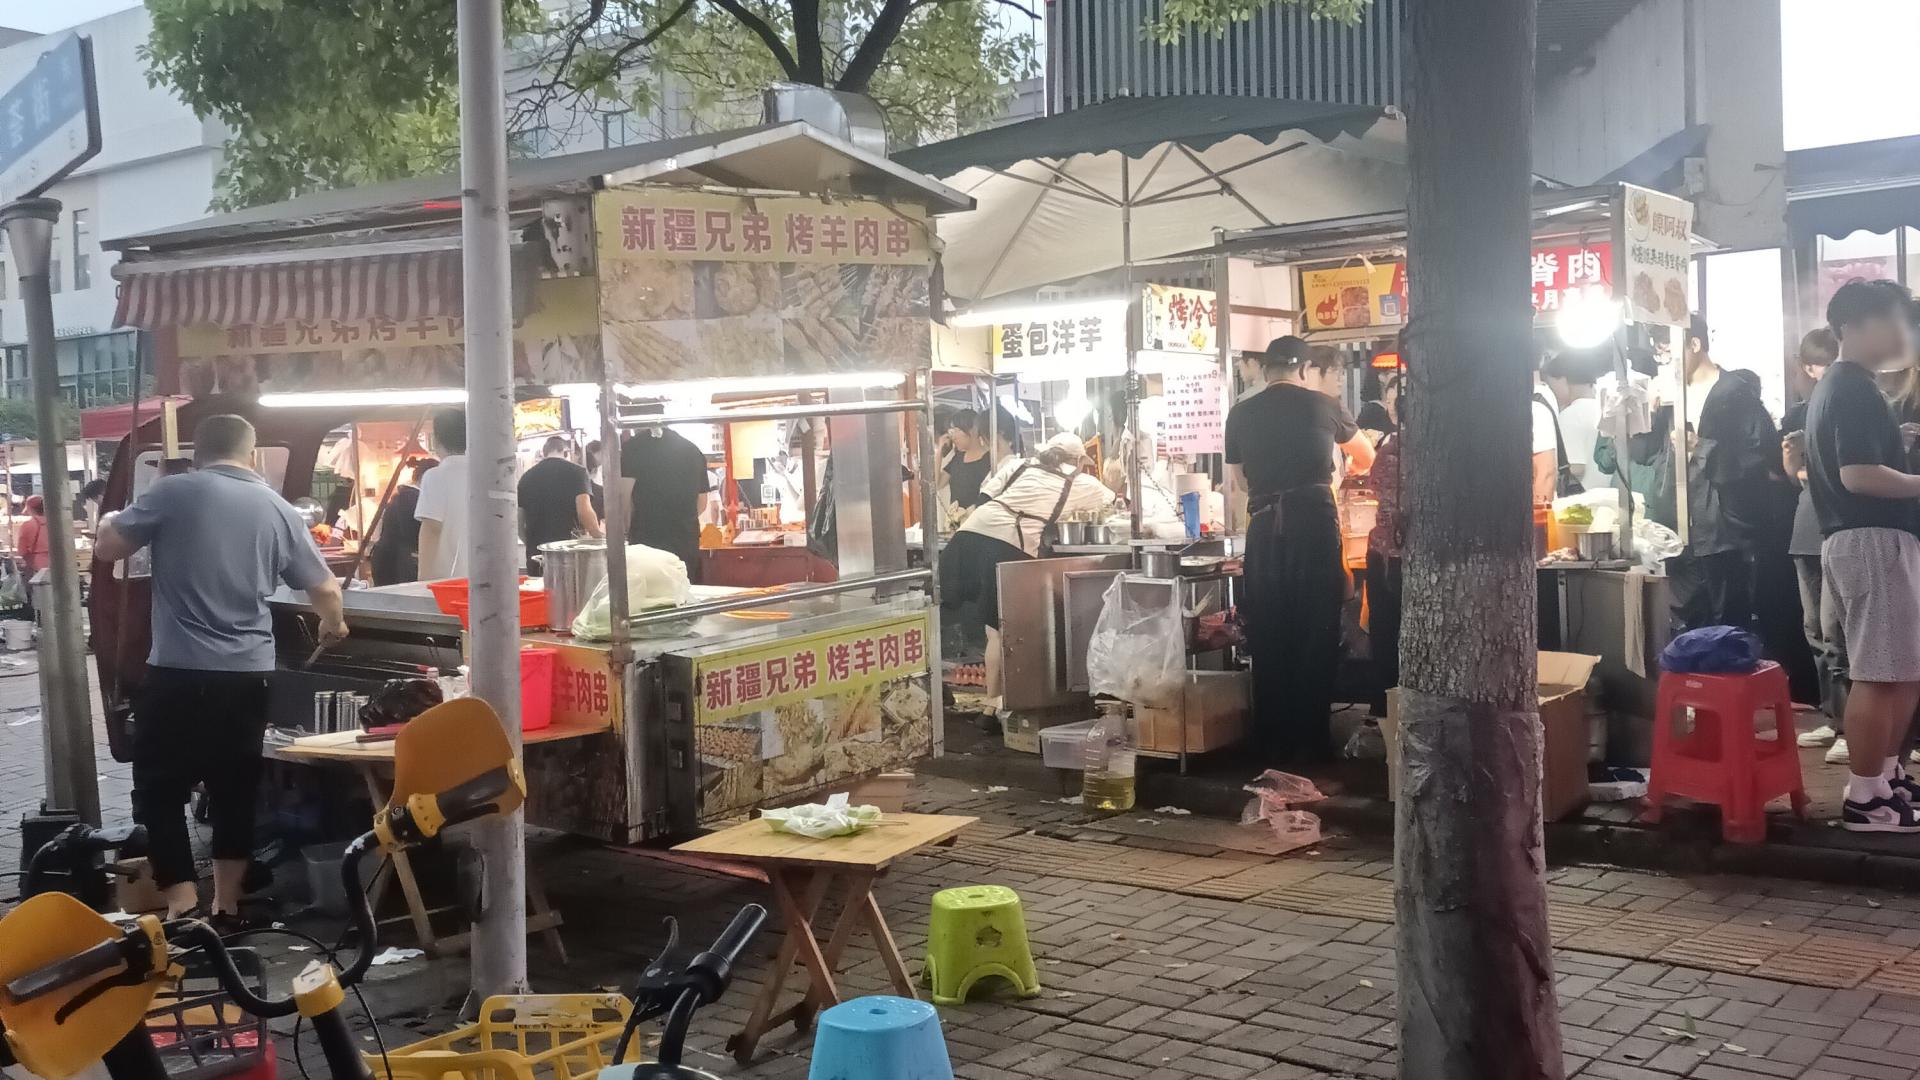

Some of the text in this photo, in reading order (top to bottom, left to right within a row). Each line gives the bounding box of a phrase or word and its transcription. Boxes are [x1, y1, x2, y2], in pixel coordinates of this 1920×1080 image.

[622, 205, 910, 257] 新疆兄弟 烤羊肉串
[1001, 316, 1102, 359] 蛋包洋芋
[553, 666, 609, 716] 羊肉串
[706, 628, 923, 710] 新疆兄弟 烤羊肉串
